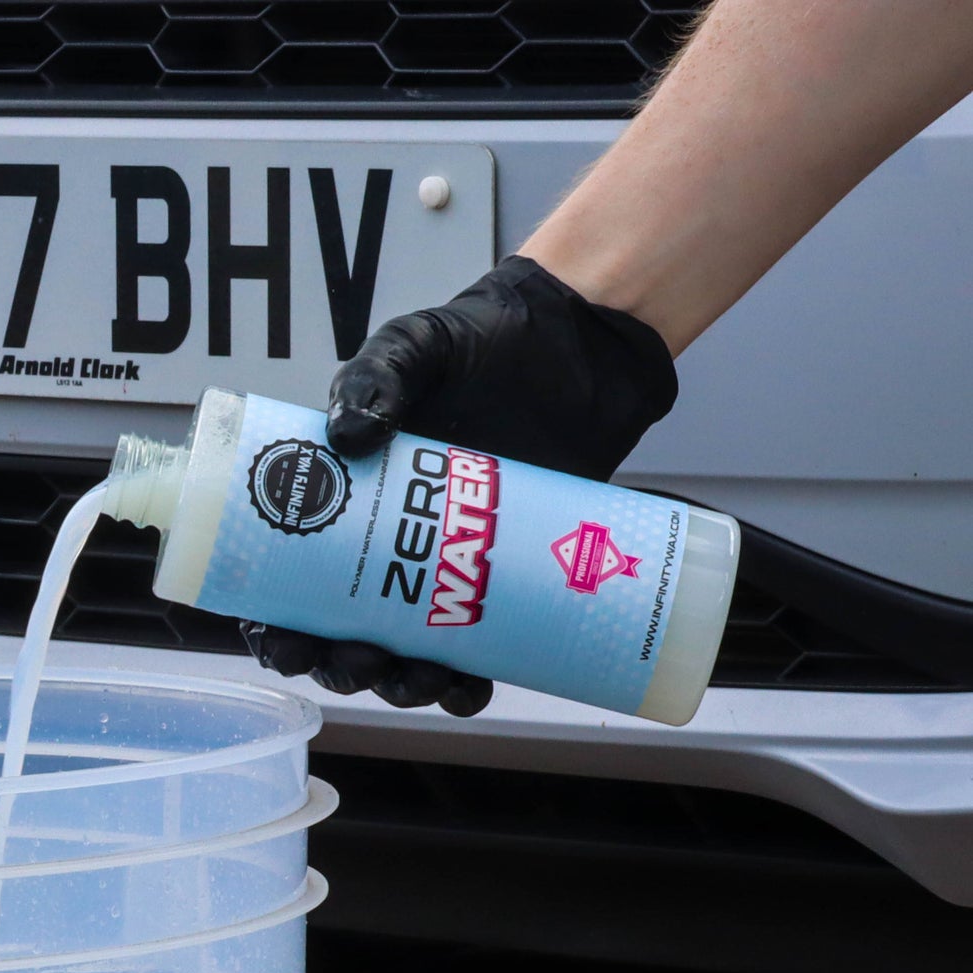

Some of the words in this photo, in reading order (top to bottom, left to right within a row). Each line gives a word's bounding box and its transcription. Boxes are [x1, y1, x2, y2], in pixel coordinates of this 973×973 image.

[110, 165, 394, 361] BHV
[80, 358, 140, 380] Clark
[284, 474, 308, 526] INFINITY
[296, 446, 315, 473] WAX
[349, 557, 366, 598] POLYMER
[363, 499, 381, 555] WATERLESS
[376, 458, 388, 497] CLEANING
[381, 448, 448, 605] ZERO
[575, 531, 594, 582] PROFESSIONAL
[640, 511, 681, 661] WWW.INFINITYWAX.COM
